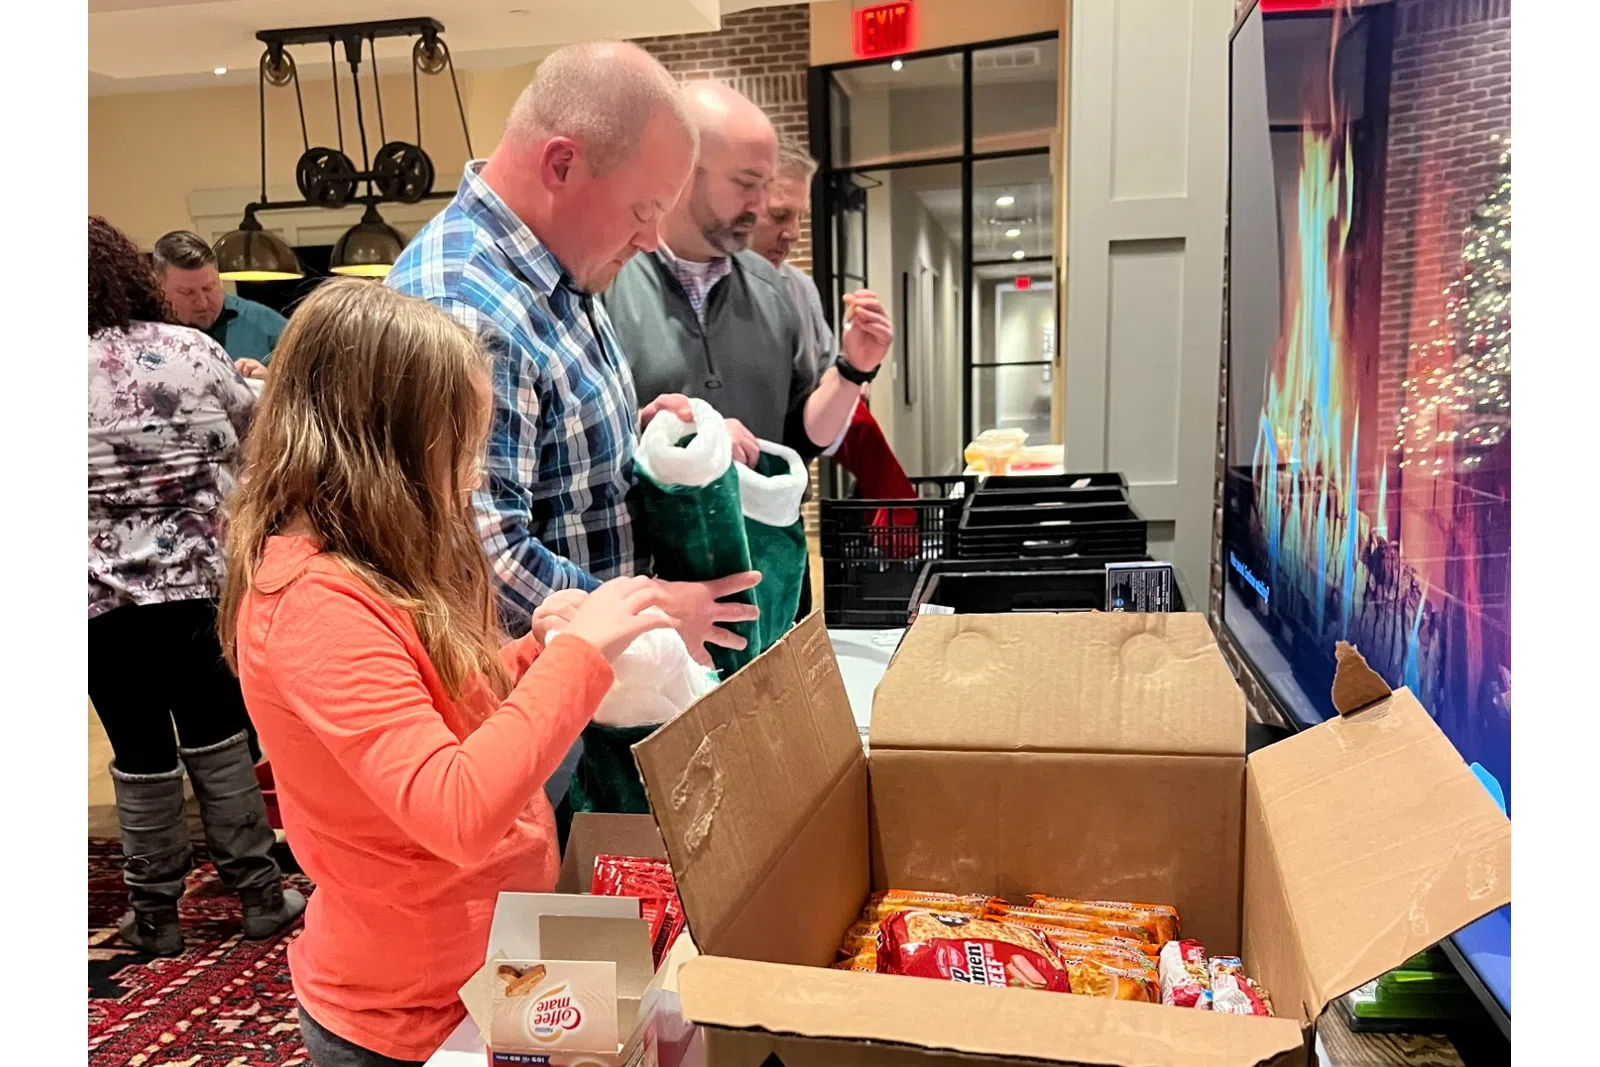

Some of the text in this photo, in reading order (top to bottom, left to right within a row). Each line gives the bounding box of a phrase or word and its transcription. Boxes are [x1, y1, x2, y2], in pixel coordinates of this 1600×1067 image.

[863, 6, 907, 51] EXIT
[967, 945, 986, 985] men
[533, 1006, 581, 1030] Coffee
[537, 996, 571, 1012] mate
